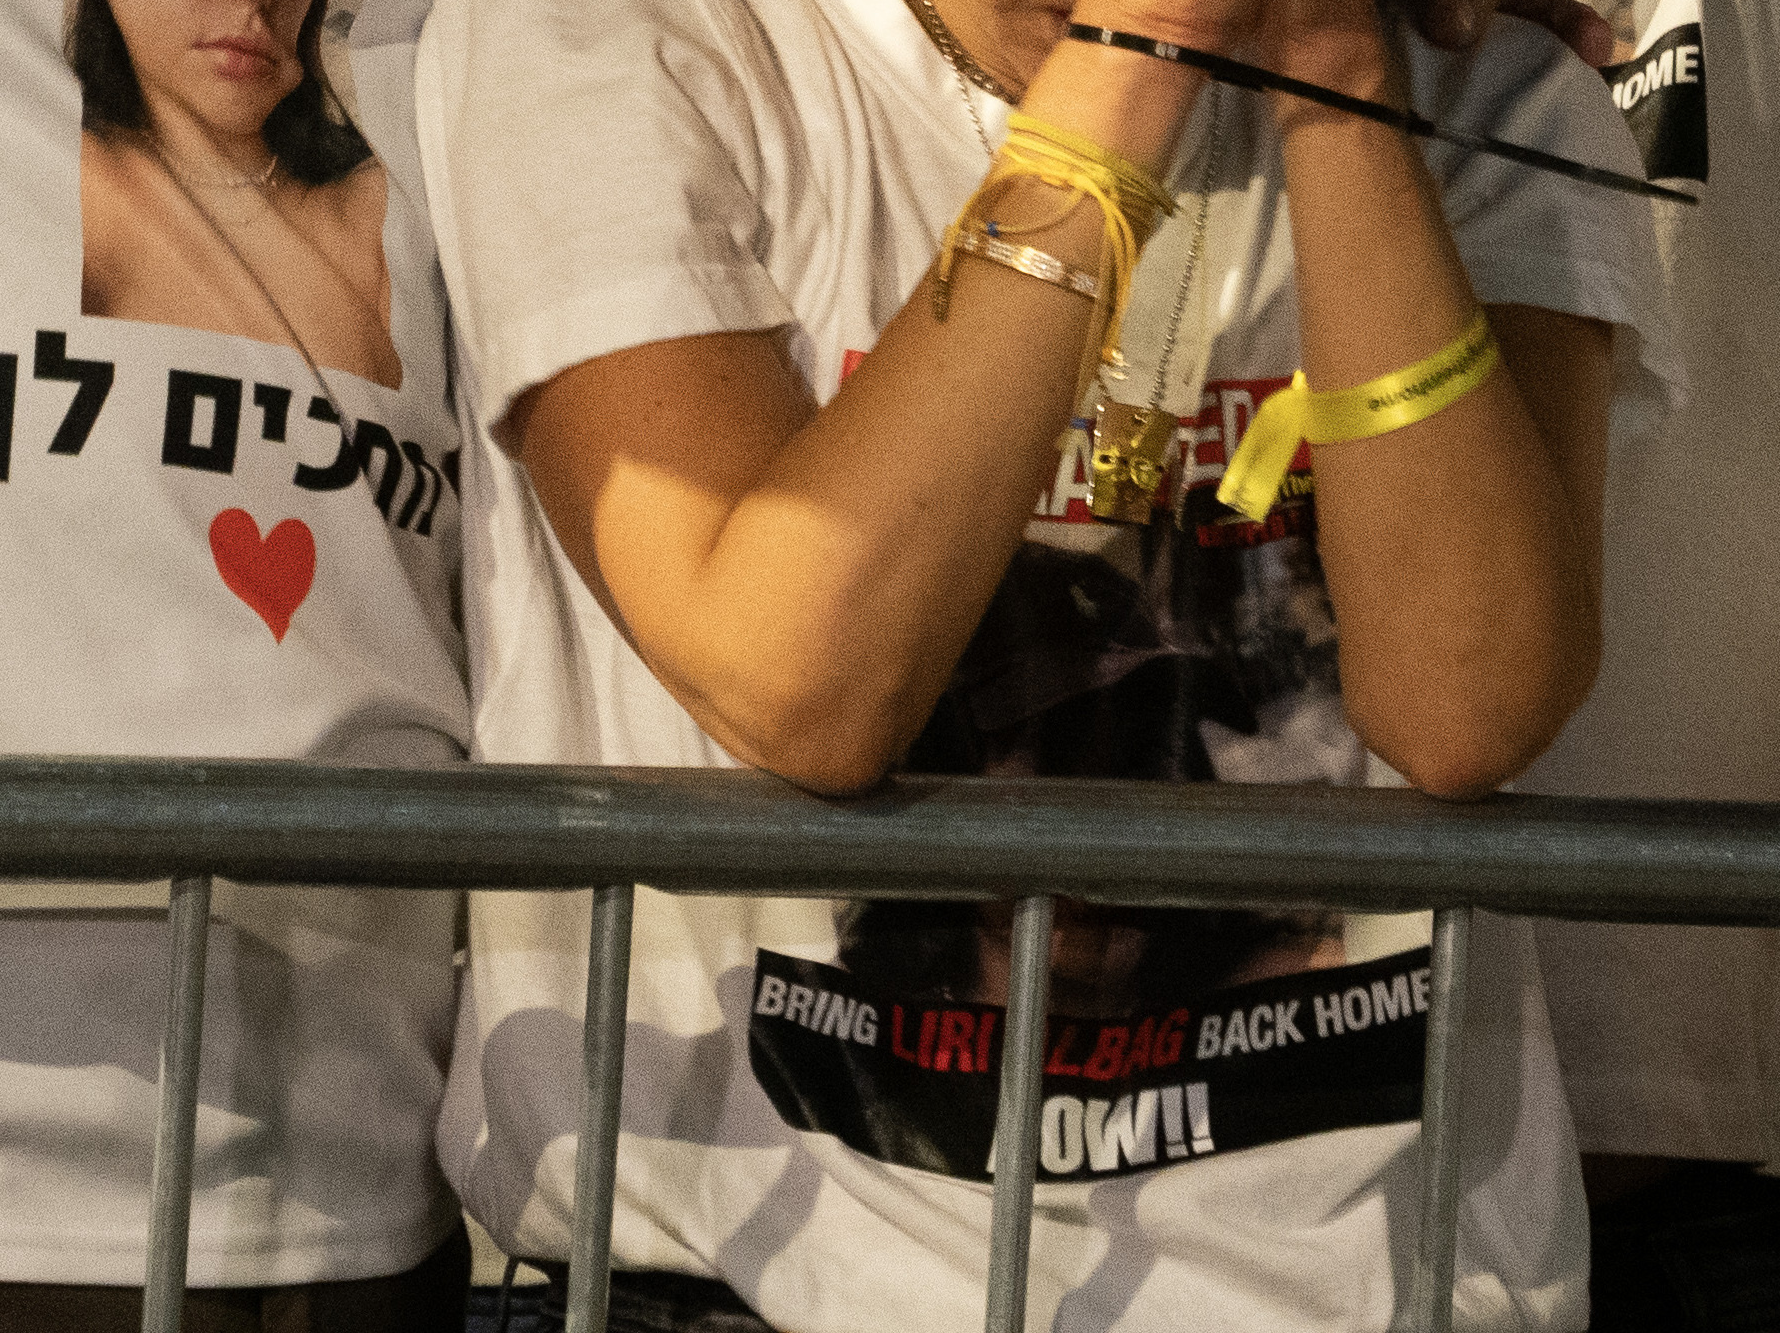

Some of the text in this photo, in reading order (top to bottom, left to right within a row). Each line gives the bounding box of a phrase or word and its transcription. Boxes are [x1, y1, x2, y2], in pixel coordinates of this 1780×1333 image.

[756, 966, 1432, 1082] BRING LIRI LBAG BACK HOME
[985, 1081, 1217, 1177] OW!!
